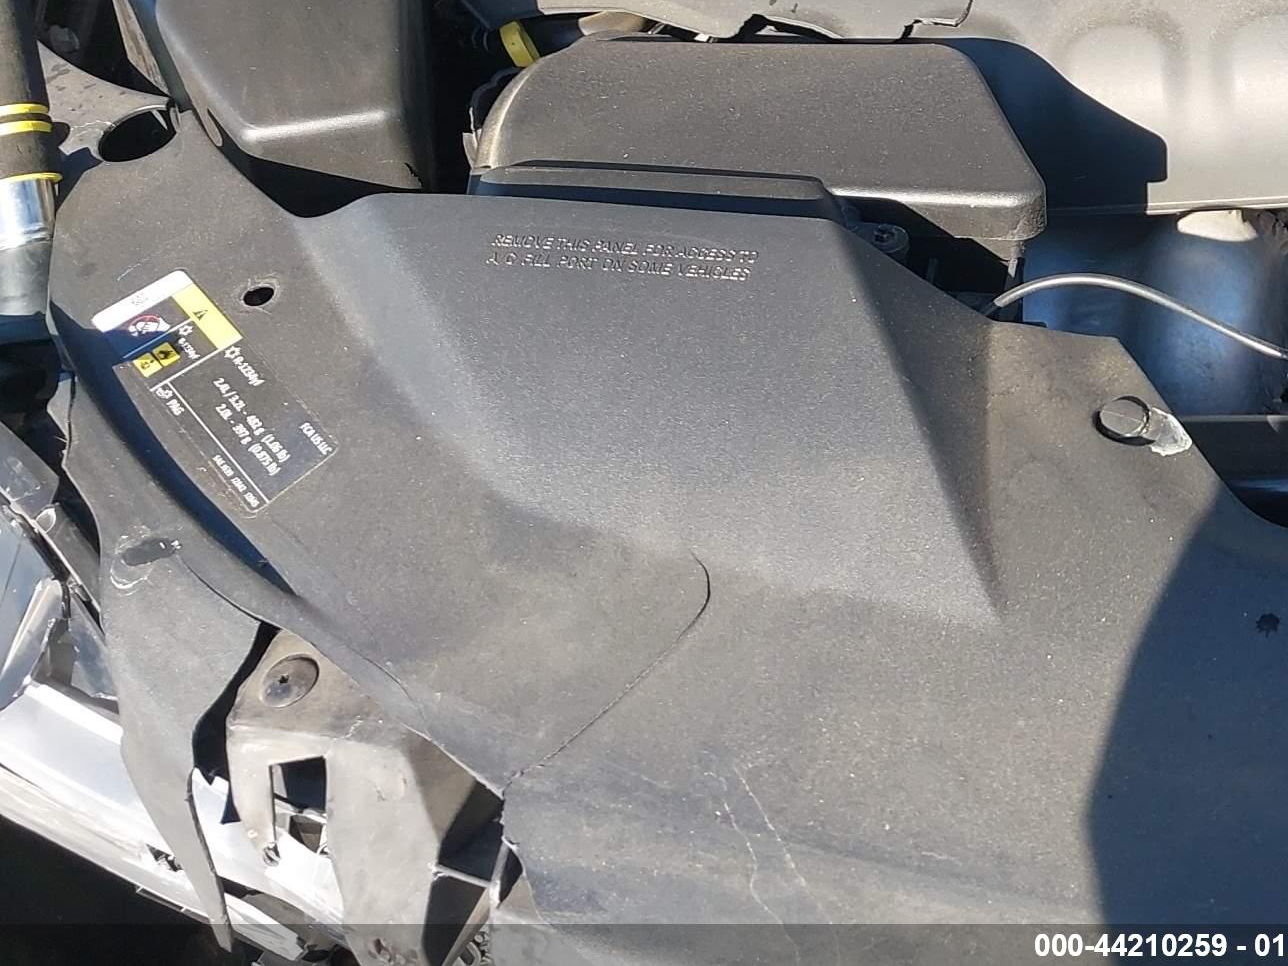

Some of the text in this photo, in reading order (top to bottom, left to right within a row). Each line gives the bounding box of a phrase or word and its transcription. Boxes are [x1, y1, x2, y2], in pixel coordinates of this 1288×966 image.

[491, 234, 760, 264] REMOVE THIS PANEL FOR ACCESS TO
[520, 254, 551, 268] FILL
[557, 256, 599, 270] PORT
[601, 258, 626, 273] ON
[627, 260, 673, 276] SOME
[676, 264, 752, 282] VEHICLES
